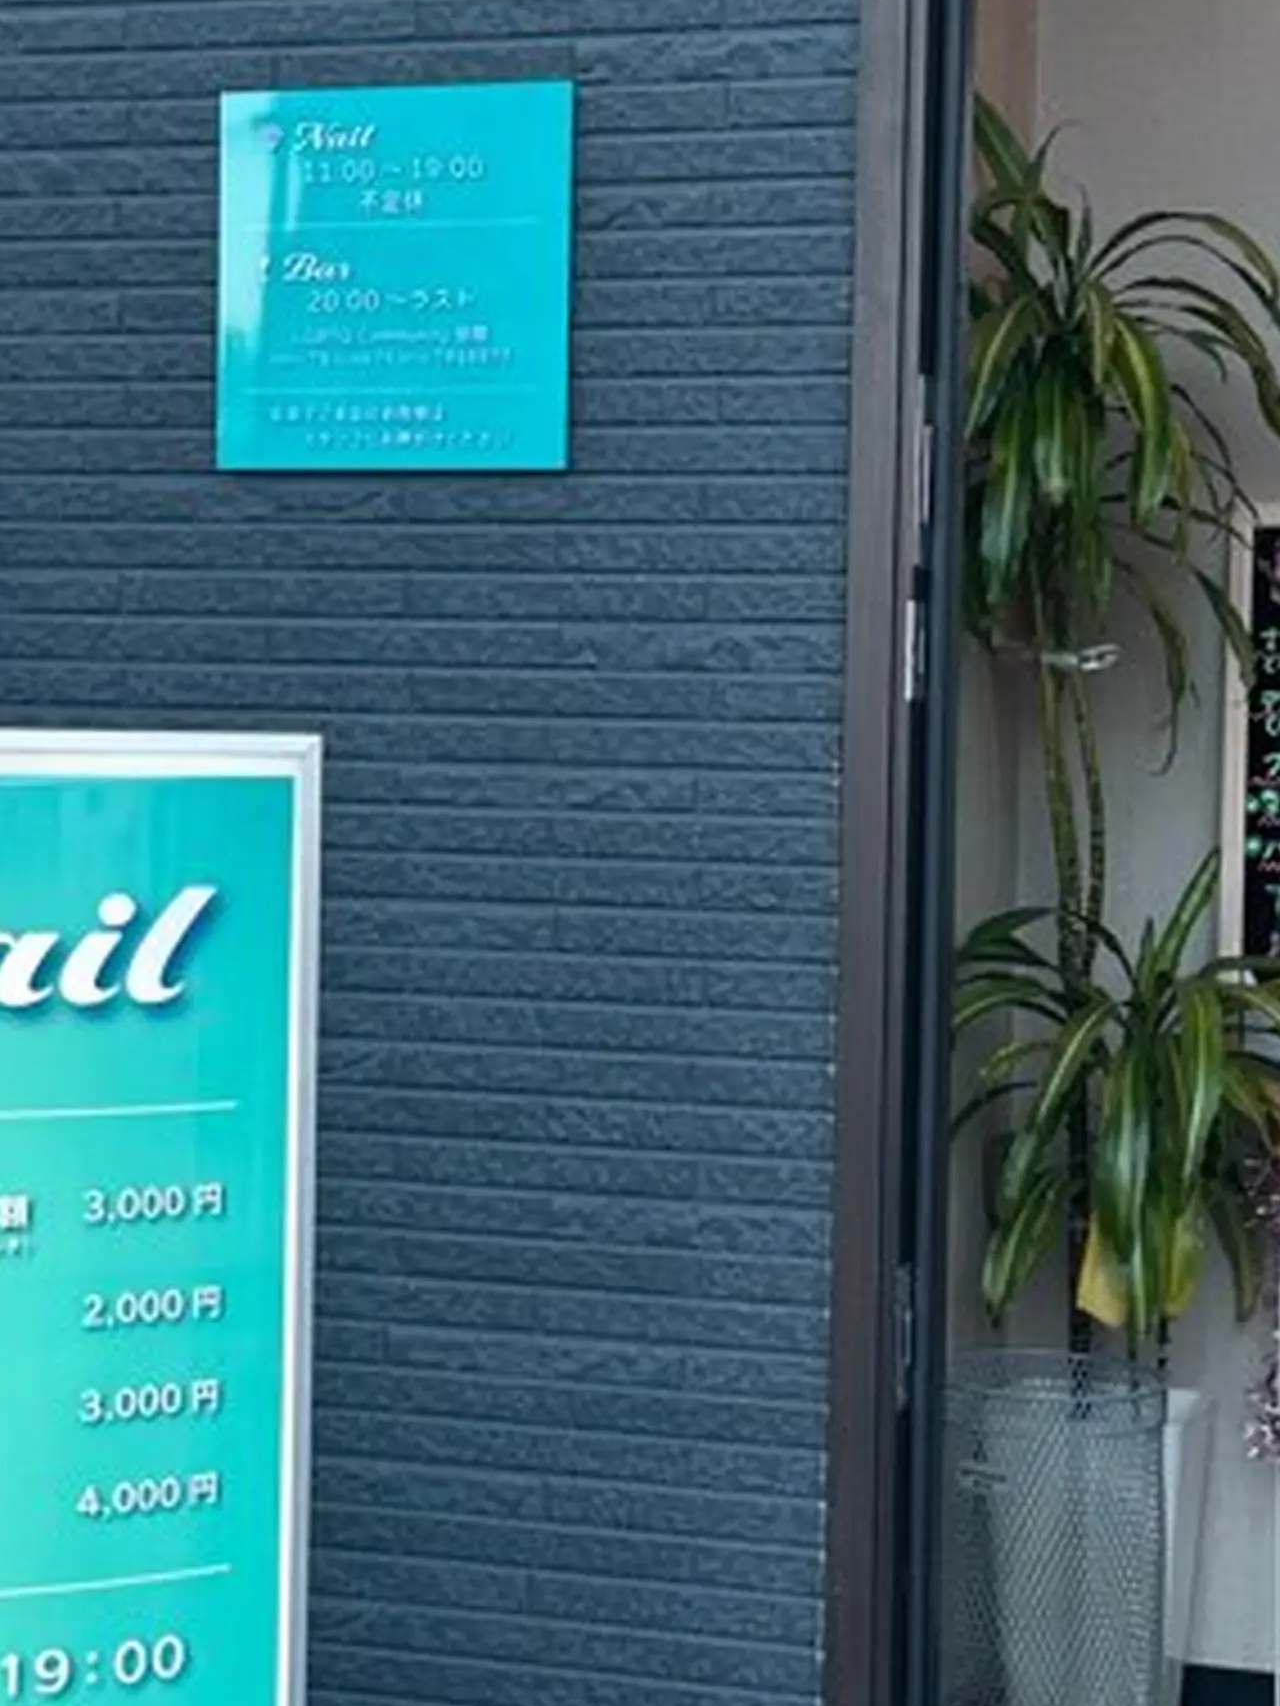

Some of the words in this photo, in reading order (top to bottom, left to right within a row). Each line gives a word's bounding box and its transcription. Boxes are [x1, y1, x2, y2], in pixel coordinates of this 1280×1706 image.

[289, 122, 377, 152] Nail
[283, 251, 350, 282] Bar
[0, 1634, 186, 1698] 19:00
